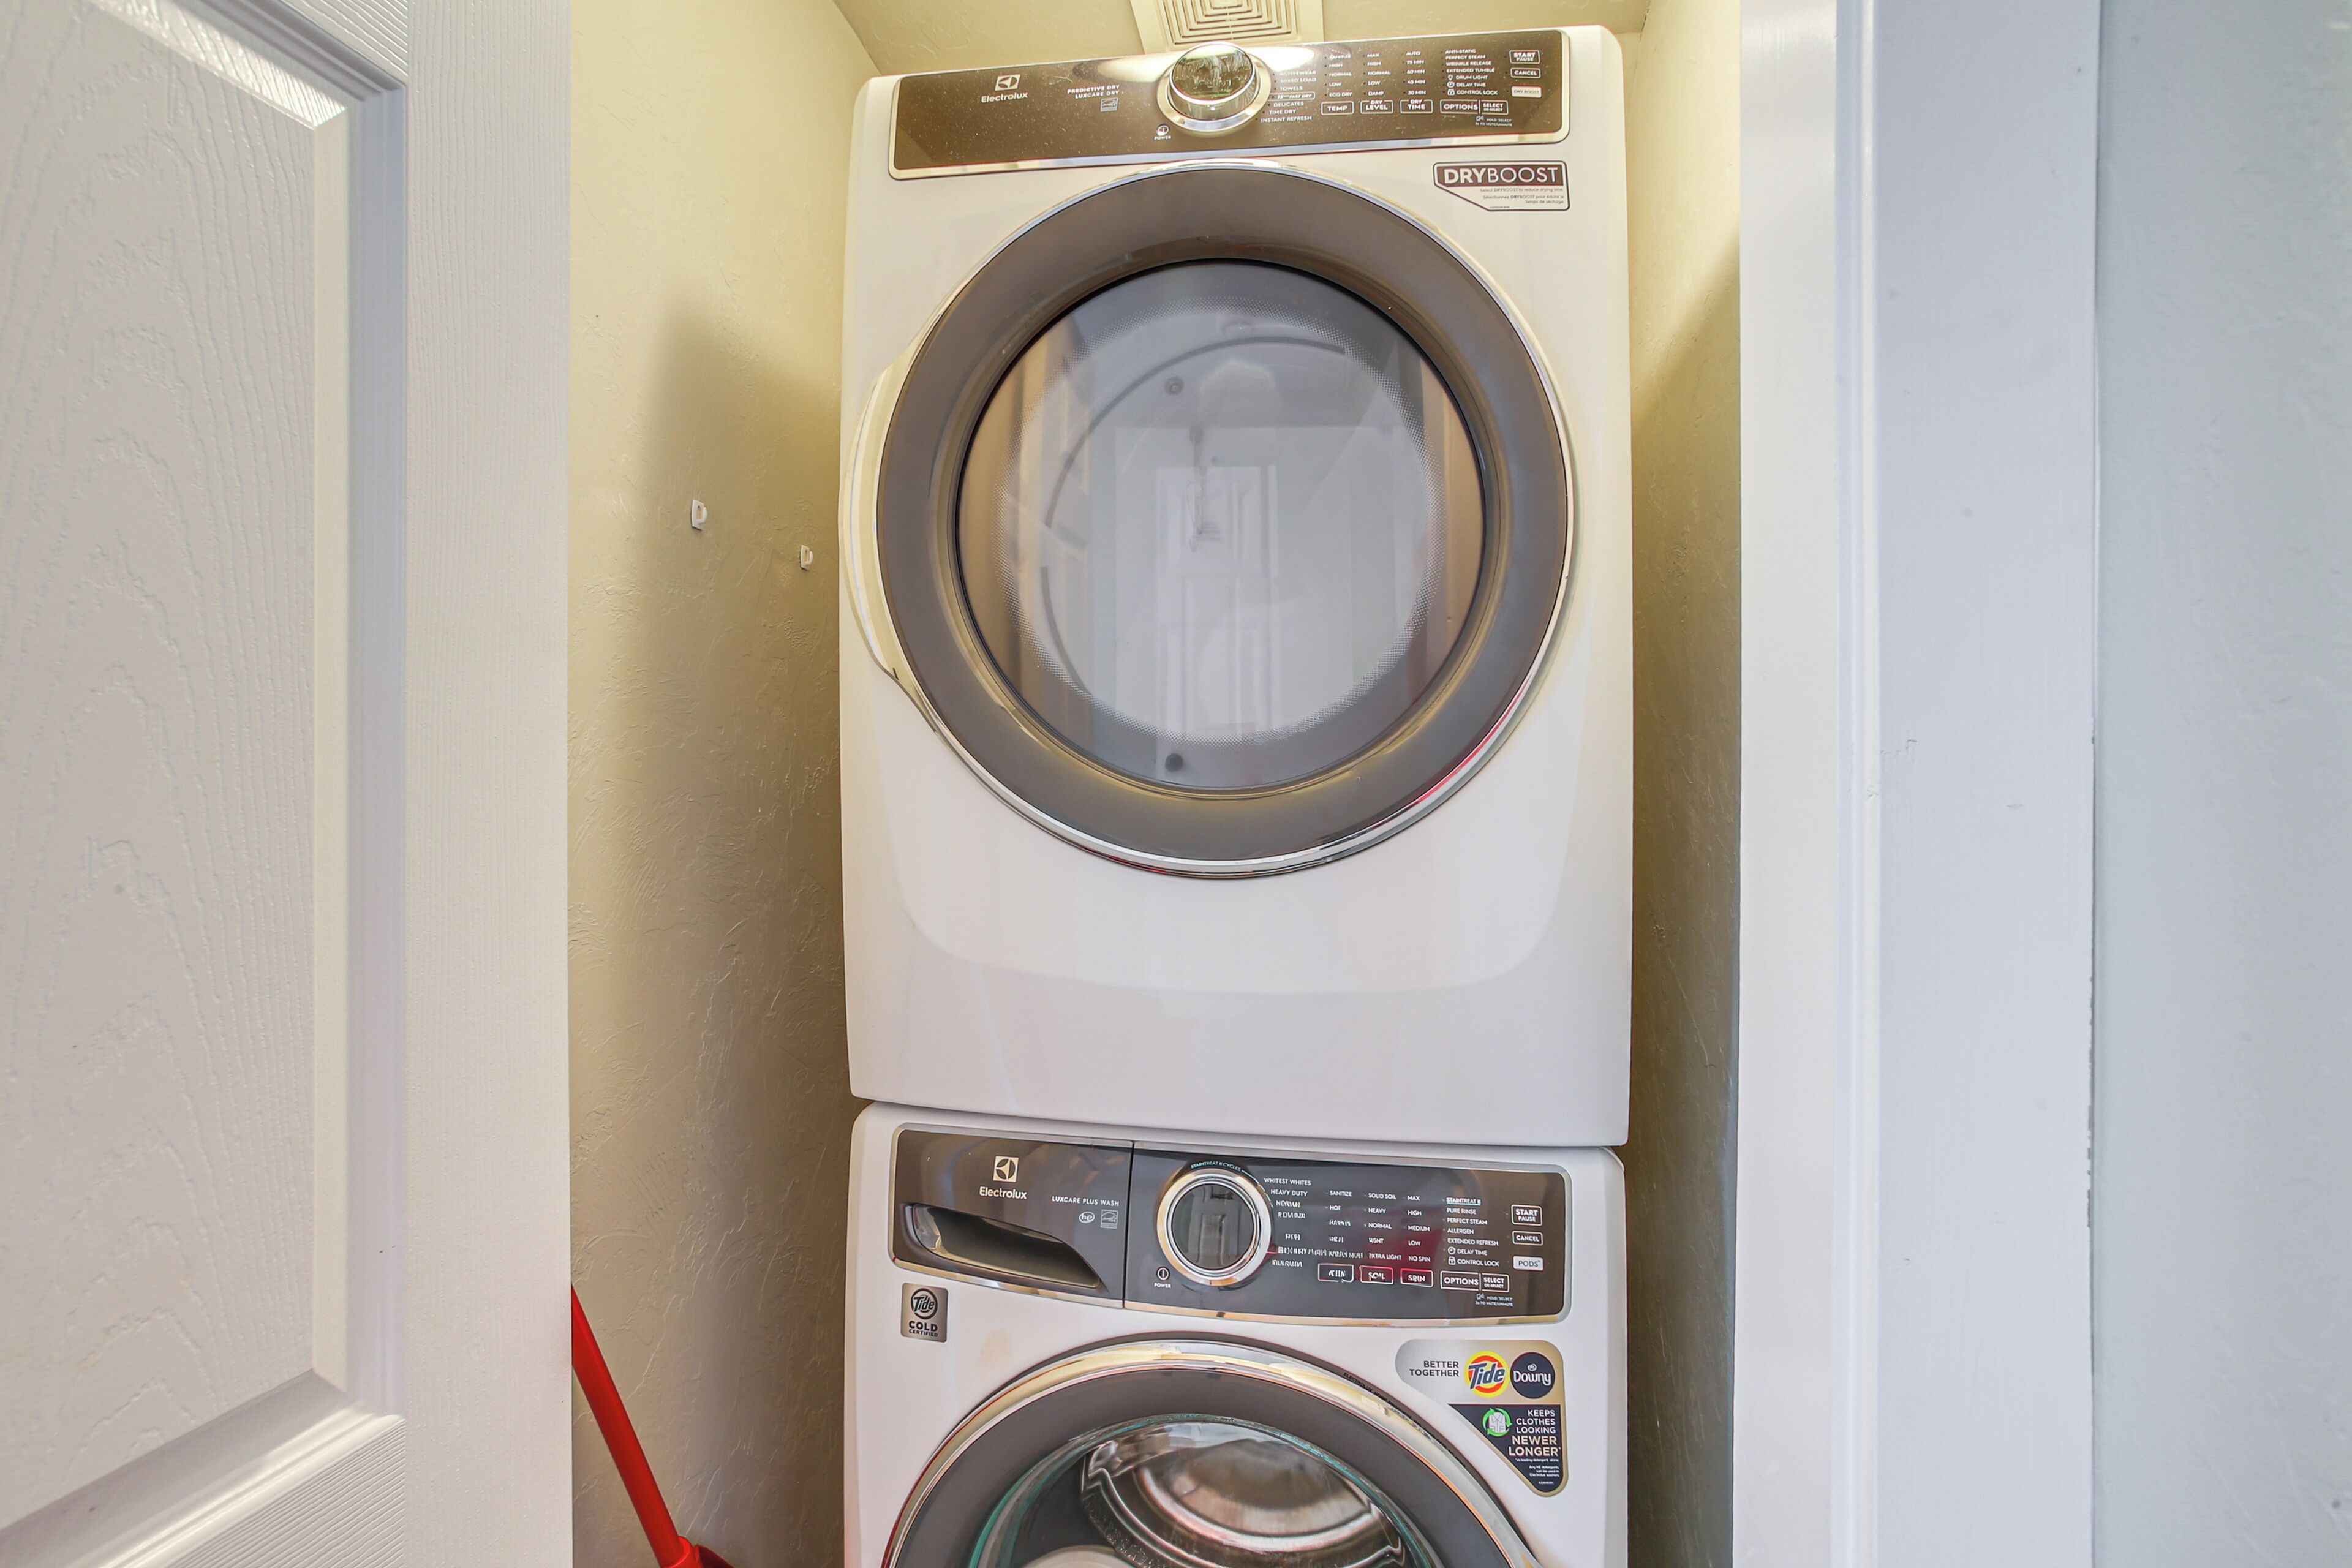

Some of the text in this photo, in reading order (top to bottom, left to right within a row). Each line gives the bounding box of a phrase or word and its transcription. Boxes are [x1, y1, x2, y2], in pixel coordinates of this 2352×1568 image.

[981, 92, 1028, 103] Electrolux
[1444, 167, 1558, 184] DRYBOOST
[979, 1186, 1027, 1199] Electrolux
[913, 1295, 935, 1312] Tide
[909, 1321, 938, 1332] COLD
[1468, 1362, 1506, 1389] Tide
[1513, 1370, 1551, 1385] Downy
[1512, 1436, 1557, 1445] NEWER
